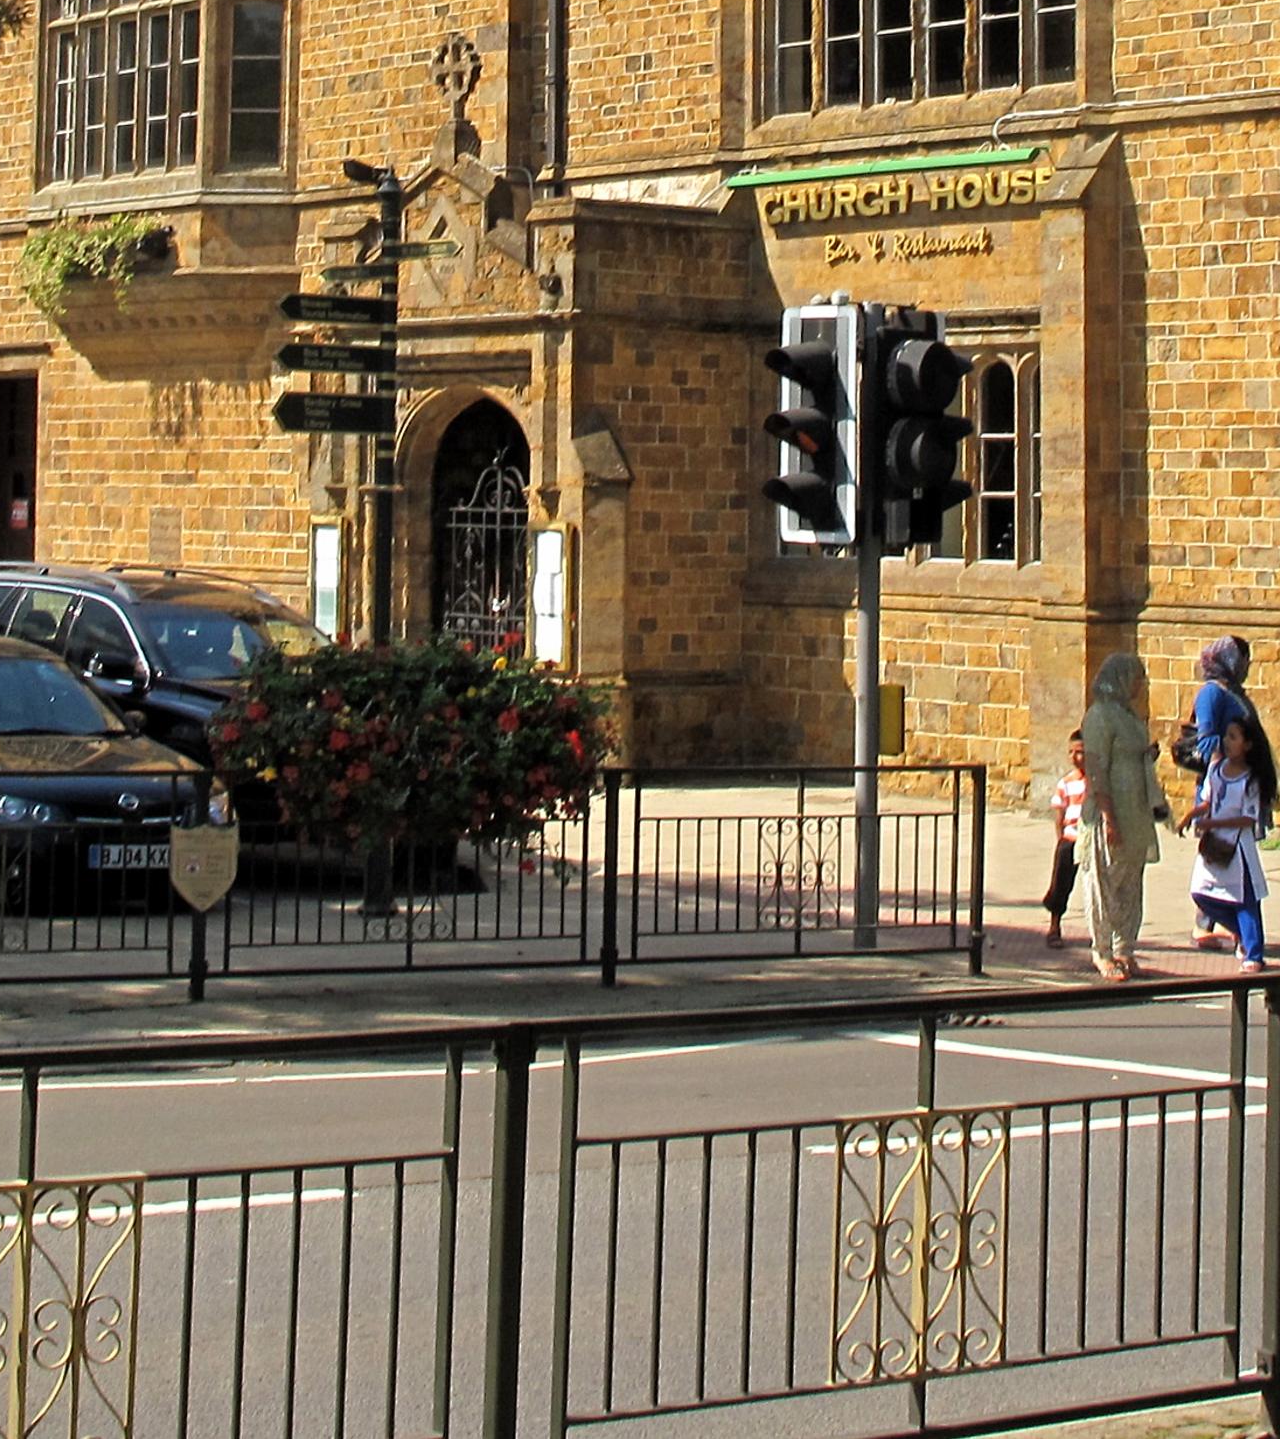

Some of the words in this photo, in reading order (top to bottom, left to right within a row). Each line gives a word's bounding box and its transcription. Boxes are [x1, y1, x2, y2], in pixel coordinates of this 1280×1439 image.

[762, 177, 910, 225] CHURCH
[929, 165, 1056, 211] HOUSE
[824, 234, 858, 264] Bar
[892, 227, 991, 260] Restaurant
[148, 847, 170, 865] KX
